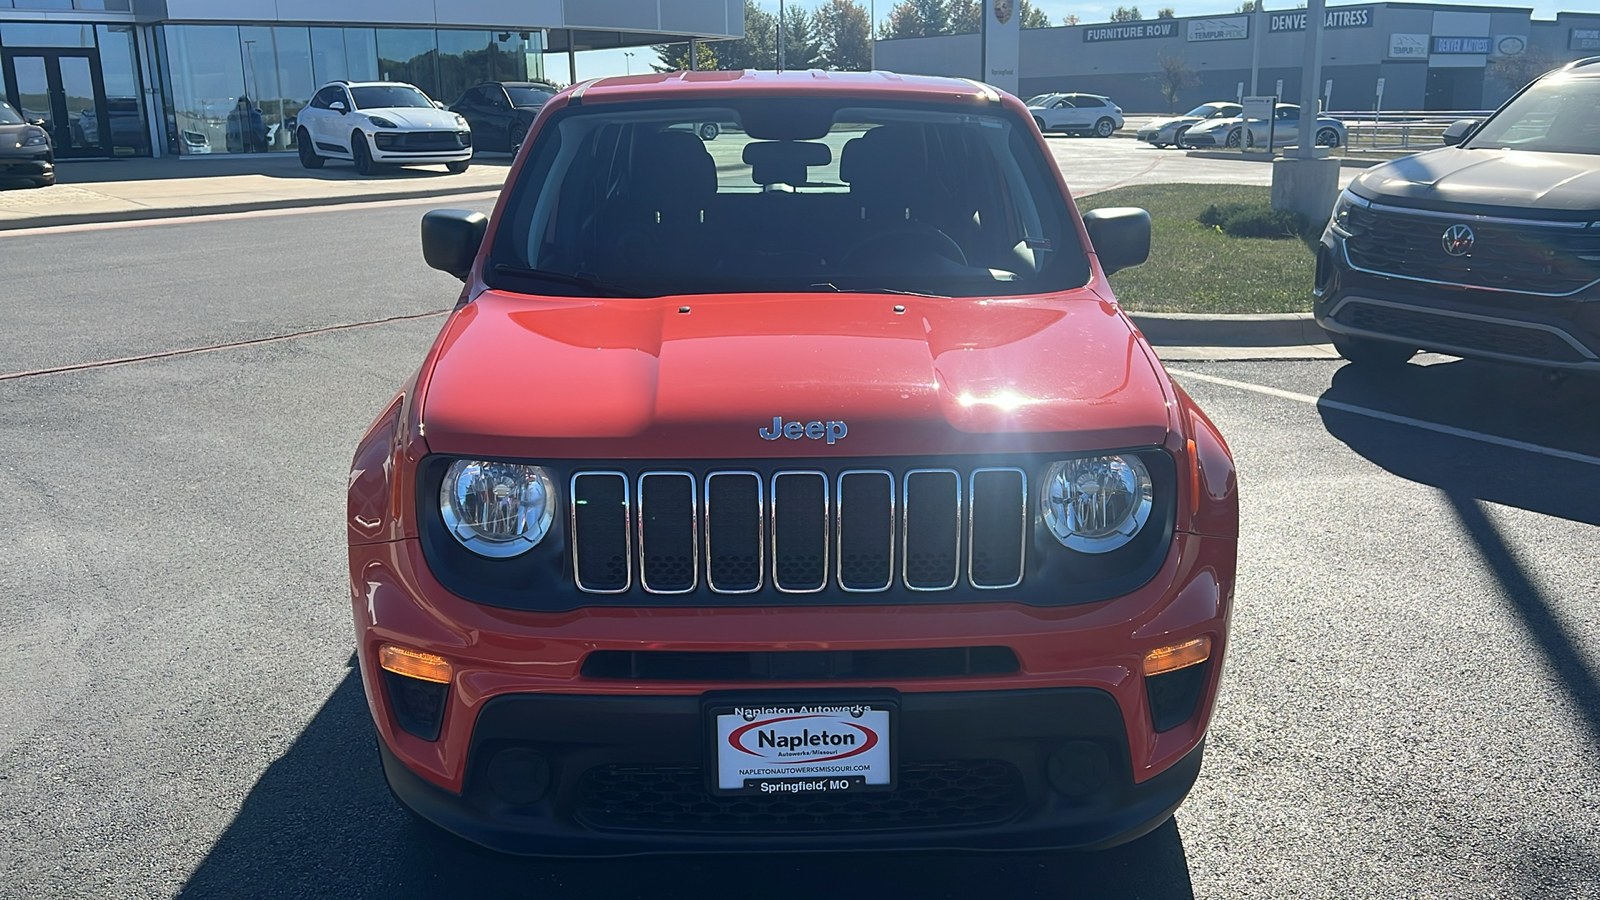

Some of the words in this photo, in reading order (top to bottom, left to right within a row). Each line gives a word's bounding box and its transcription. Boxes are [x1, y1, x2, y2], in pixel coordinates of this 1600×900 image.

[1272, 14, 1307, 30] DENVE
[1324, 10, 1368, 27] ATTRESS
[1087, 26, 1143, 40] FURNITURE
[1146, 24, 1172, 36] ROW
[759, 416, 848, 444] Jeep
[734, 706, 795, 718] Napleton
[800, 704, 872, 715] Autowerks
[758, 729, 855, 750] Napleton
[738, 765, 871, 776] NAPLETONAUTOWERKSMISSOURI.COM
[760, 780, 826, 793] Springfield,
[829, 779, 849, 790] MO
